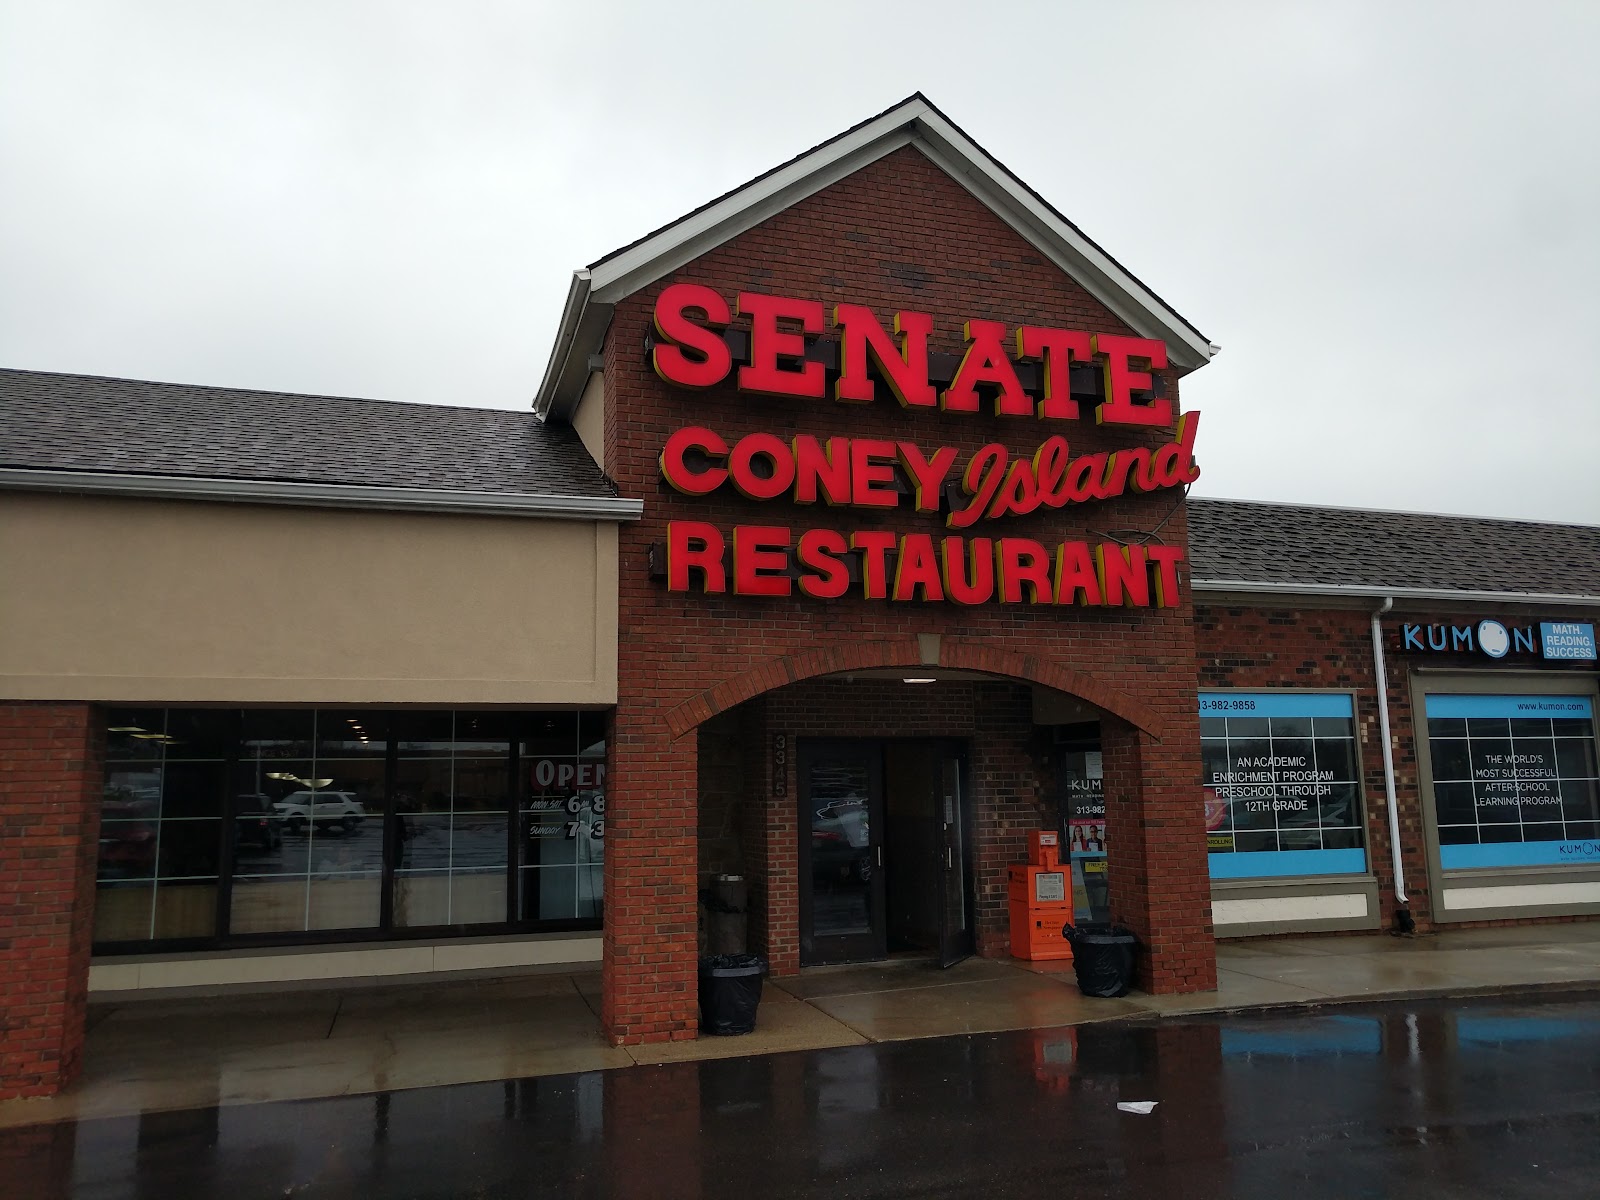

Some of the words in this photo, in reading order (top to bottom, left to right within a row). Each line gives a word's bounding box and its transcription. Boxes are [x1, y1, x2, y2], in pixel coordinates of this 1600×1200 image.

[653, 283, 1172, 427] SENATE
[661, 426, 959, 513] CONEY
[946, 411, 1201, 529] Island
[667, 520, 1184, 608] RESTAURANT
[1552, 624, 1583, 635] MATH.
[1403, 619, 1534, 658] KUMON
[1546, 635, 1593, 646] READING.
[1546, 647, 1595, 658] SUCCESS.
[1517, 702, 1584, 711] www.kumon.com
[1237, 757, 1252, 767] AN
[1253, 756, 1307, 767] ACADEMIC
[1485, 755, 1503, 764] THE
[1504, 754, 1544, 764] WORLD'S
[1213, 771, 1281, 783] ENRICHMENT
[1283, 770, 1334, 782] PROGRAM
[1476, 769, 1500, 778] MOST
[1502, 768, 1556, 778] SUCCESSFUL
[1215, 786, 1280, 798] PRESCHOOL
[1281, 785, 1332, 796] THROUGH
[1485, 782, 1551, 792] AFTER-SCHOOL
[1245, 801, 1270, 812] 12TH
[1272, 800, 1308, 811] GRADE
[1475, 797, 1519, 807] LEARNING
[1521, 796, 1563, 806] PROGRAM
